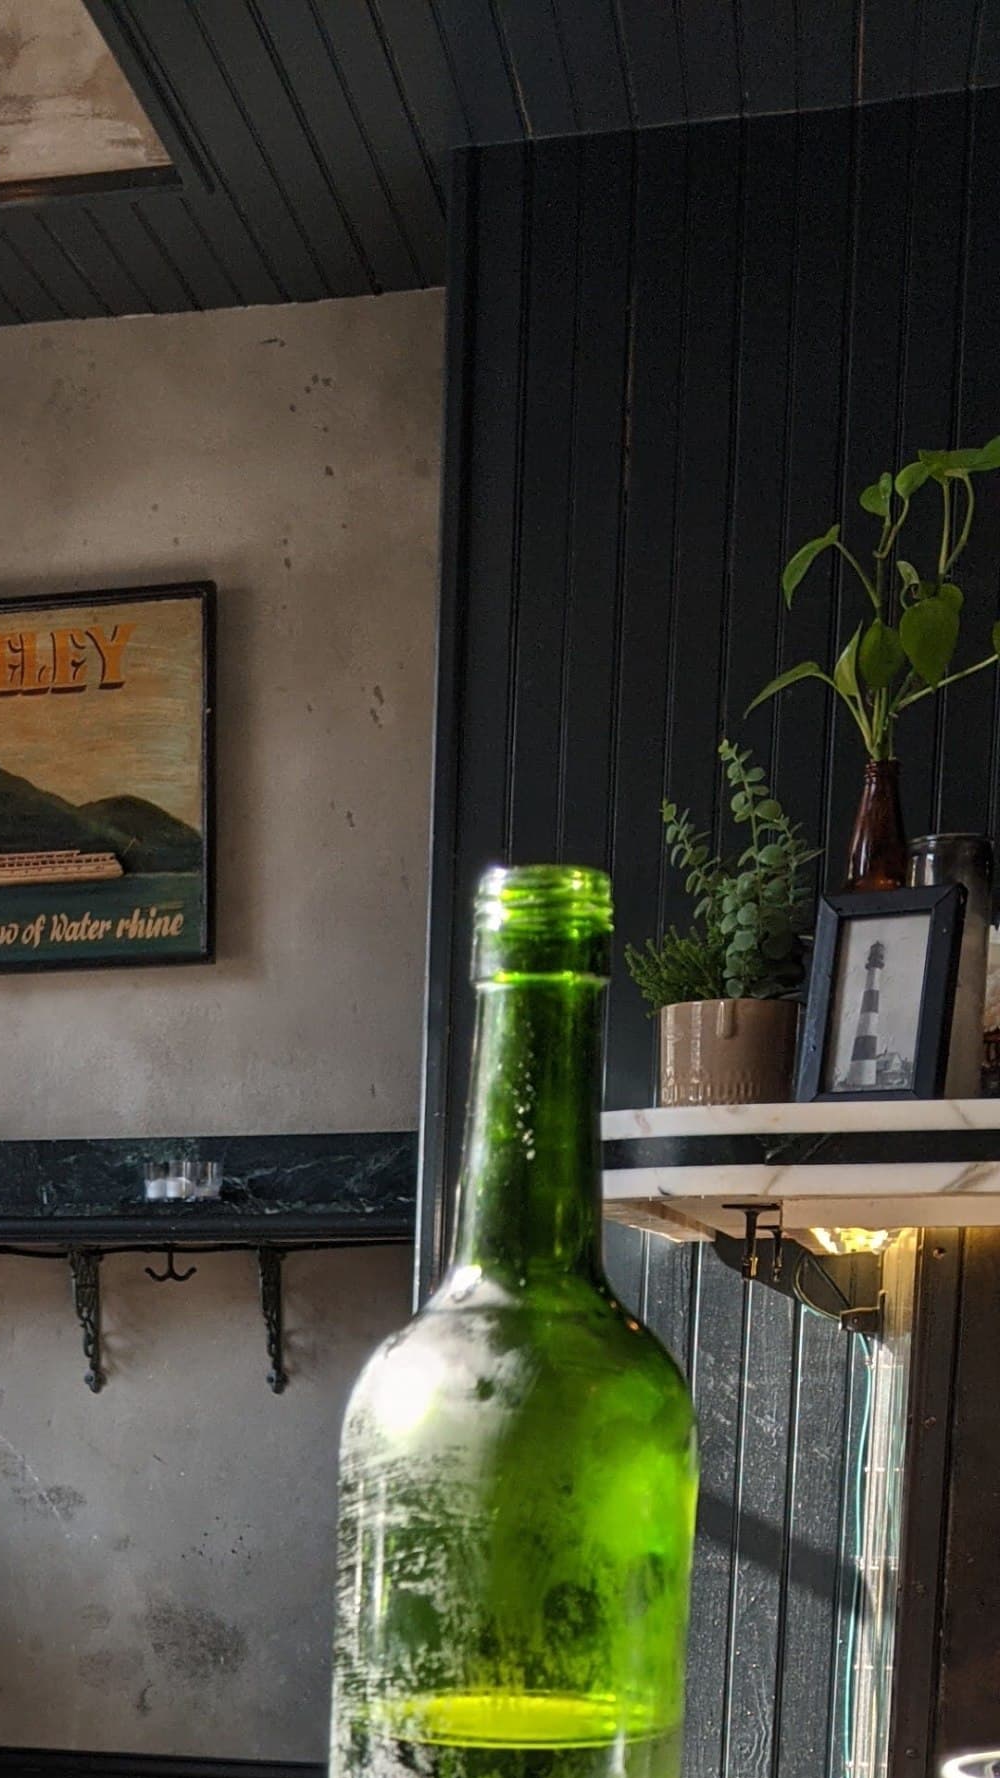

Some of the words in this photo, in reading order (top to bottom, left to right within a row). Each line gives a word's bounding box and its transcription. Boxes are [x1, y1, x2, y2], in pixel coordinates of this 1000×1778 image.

[22, 913, 46, 948] of
[49, 911, 112, 941] Water
[116, 907, 184, 939] rhine
